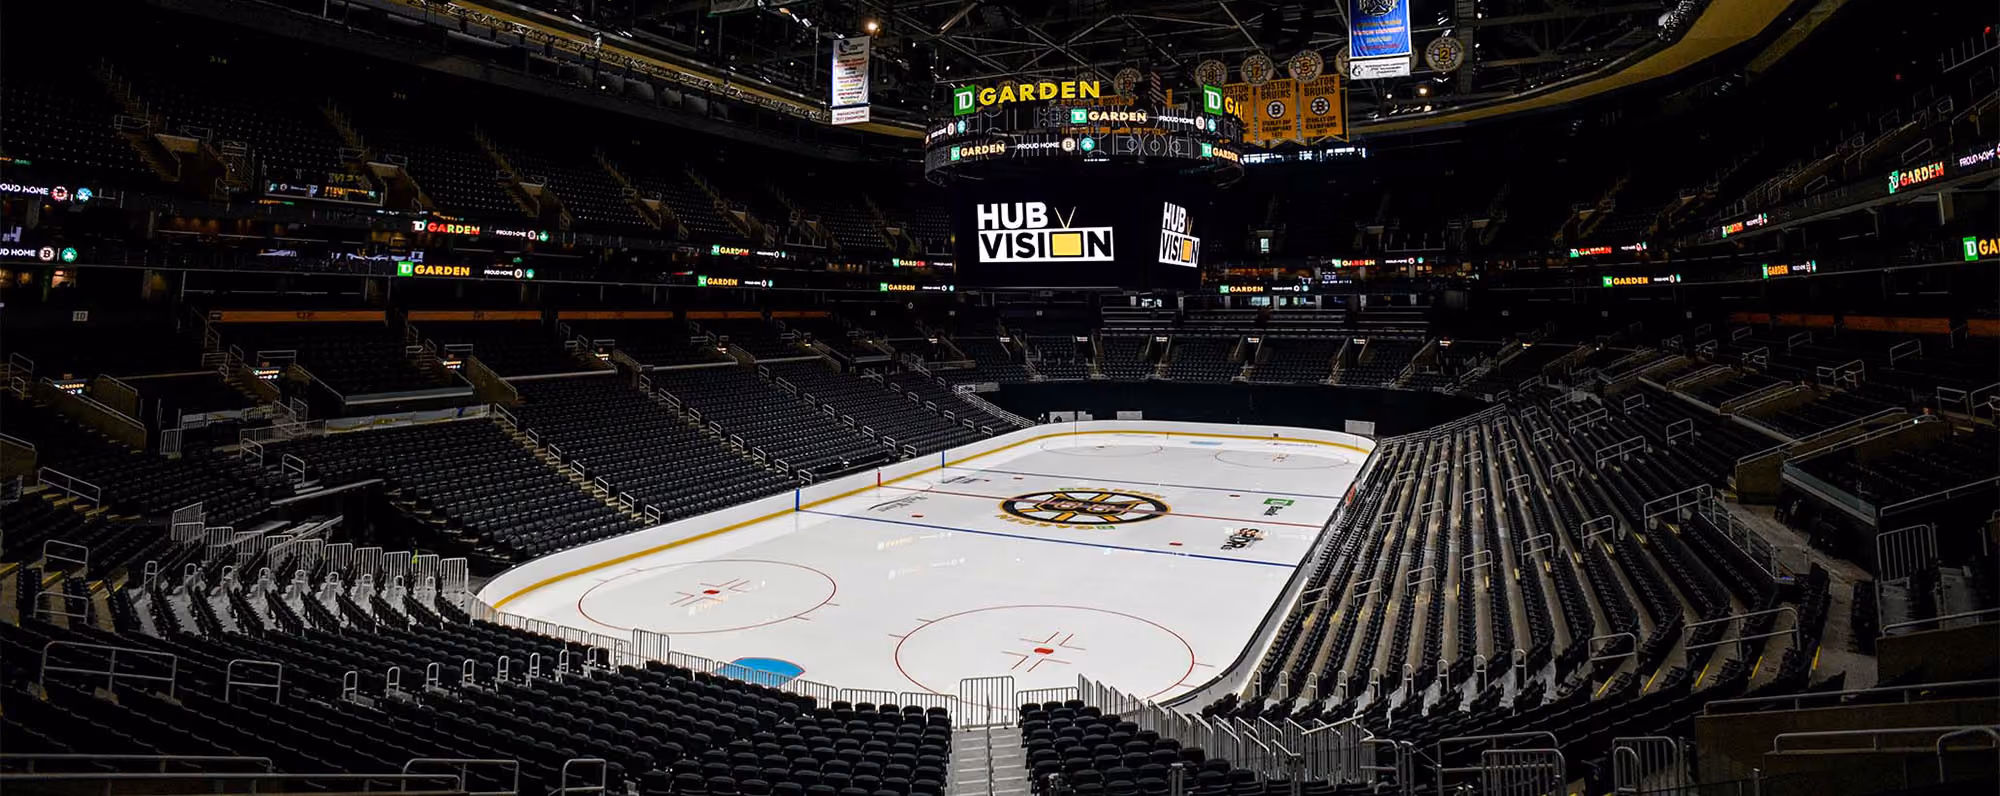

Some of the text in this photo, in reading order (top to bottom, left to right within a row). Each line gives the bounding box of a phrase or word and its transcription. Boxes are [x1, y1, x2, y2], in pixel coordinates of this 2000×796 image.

[1440, 49, 1449, 60] 2
[1261, 79, 1291, 91] BOSTON
[956, 81, 1100, 110] TD GARDEN
[1261, 89, 1291, 100] BRUINS
[1304, 87, 1335, 97] BRUINS
[1205, 90, 1221, 111] TD
[1088, 111, 1147, 122] GARDEN
[961, 143, 1005, 157] GARDEN
[1017, 143, 1039, 151] PROUD
[1212, 147, 1238, 162] GARDEN
[1900, 162, 1944, 186] GARDEN
[0, 183, 49, 196] OUD HOME
[977, 202, 1048, 230] HUB
[1164, 202, 1186, 232] HUB
[427, 222, 480, 236] GARDEN
[11, 248, 36, 257] HOME
[720, 247, 750, 256] GARDEN
[1579, 246, 1612, 256] GARDEN
[414, 264, 470, 277] GARDEN
[707, 277, 738, 286] GARDEN
[1613, 276, 1648, 286] GARDEN
[1229, 285, 1263, 293] GARDEN
